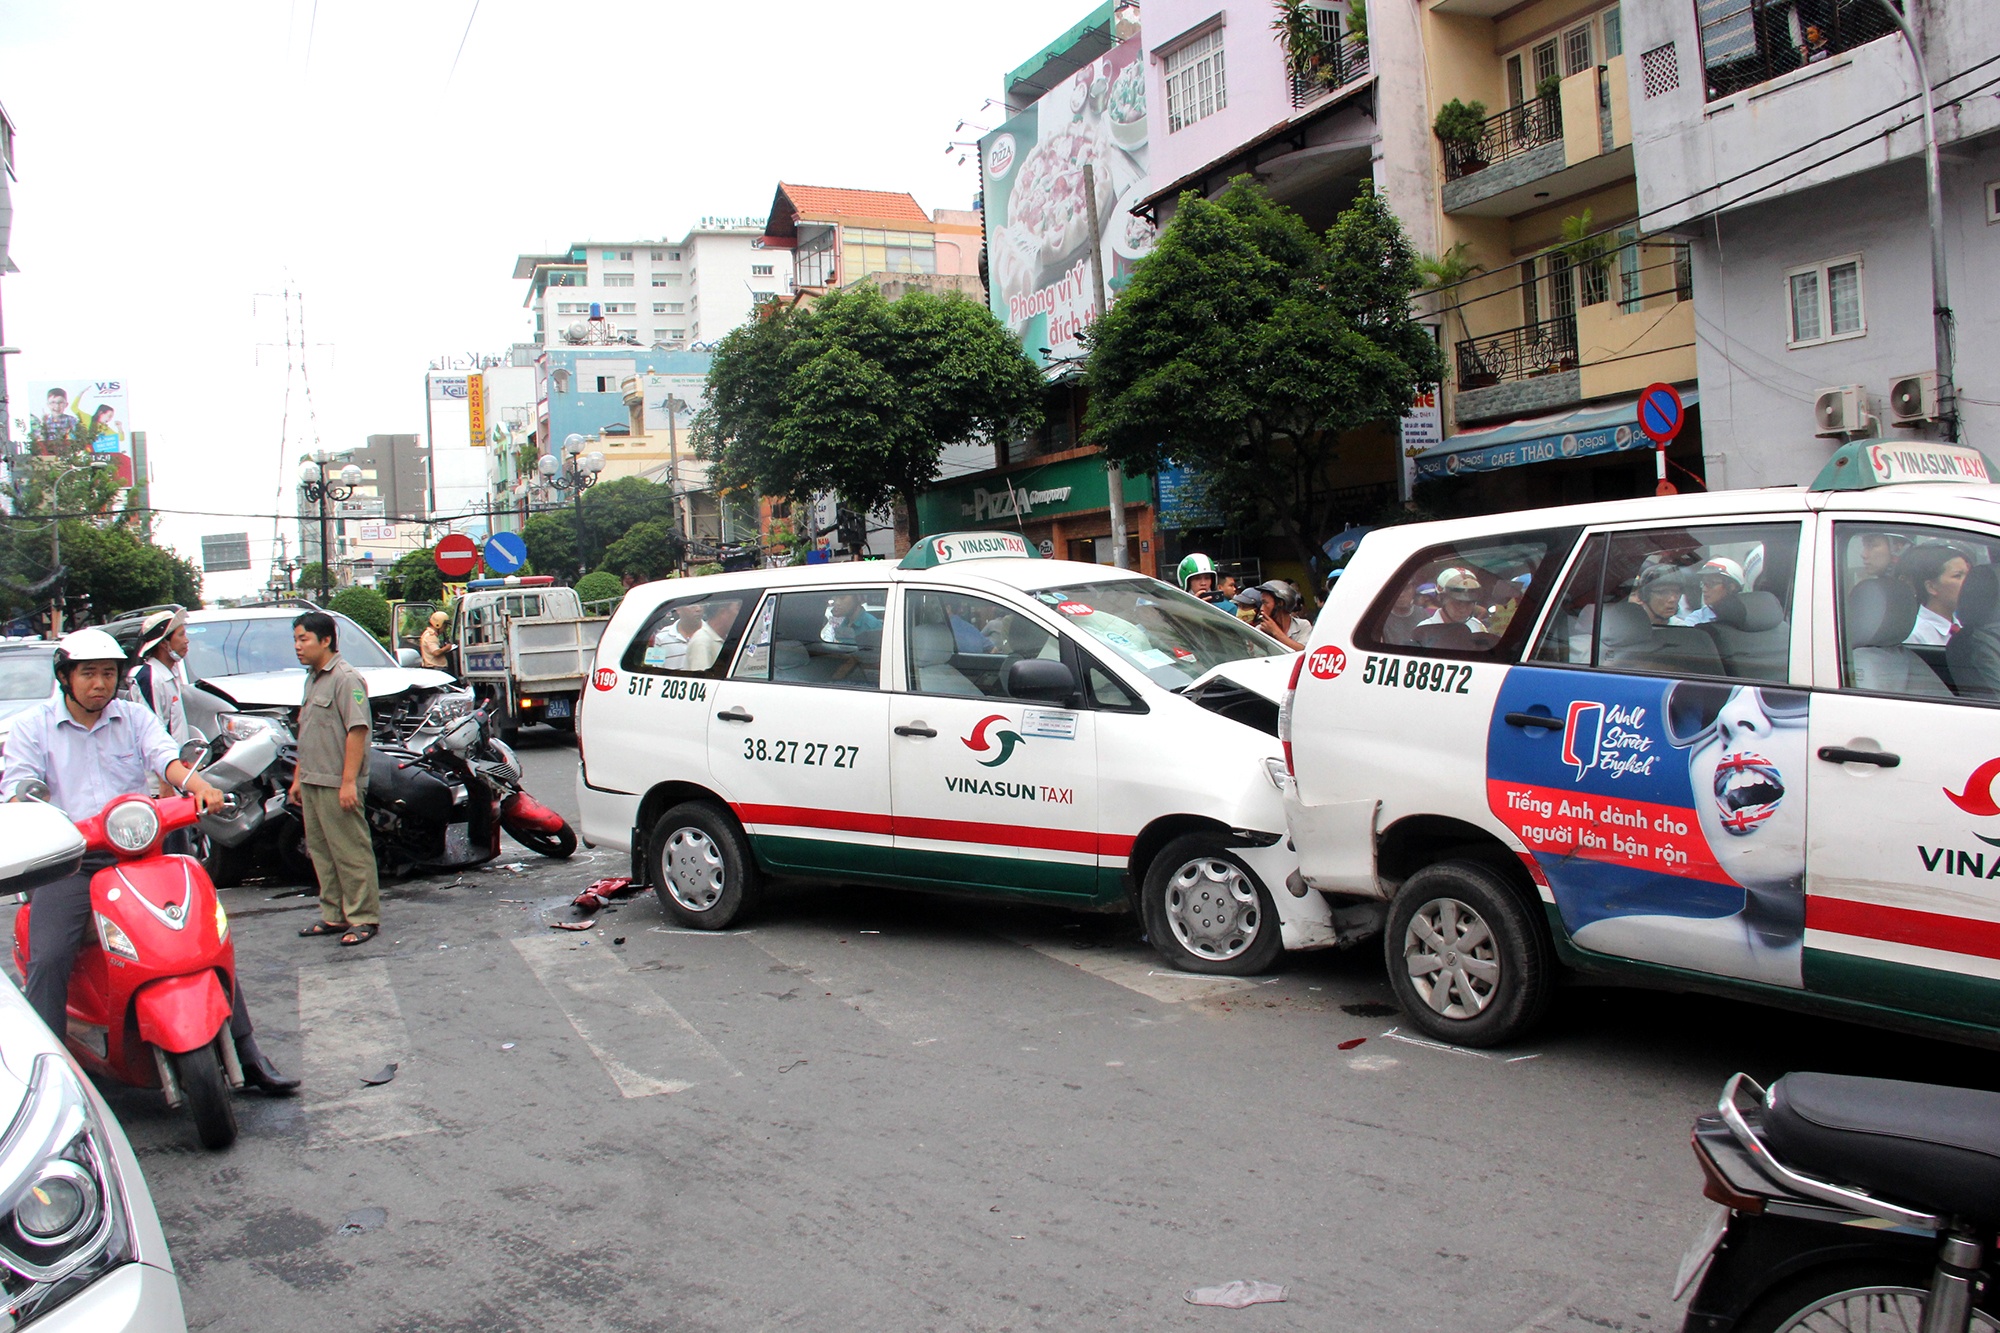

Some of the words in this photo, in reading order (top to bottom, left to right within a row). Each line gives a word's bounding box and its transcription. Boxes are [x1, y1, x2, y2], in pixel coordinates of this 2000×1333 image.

[1010, 286, 1055, 323] Phong
[1057, 272, 1072, 307] vị
[1073, 260, 1084, 296] Ý
[1049, 311, 1081, 346] đích
[1491, 450, 1515, 466] CAFÉ
[1521, 441, 1554, 461] THẢO
[1578, 433, 1606, 451] pepsi
[1893, 451, 1958, 475] VINASUN
[1954, 456, 1986, 478] TAXI
[974, 487, 1032, 521] PIZZA
[958, 538, 1007, 554] VINASUN
[1002, 537, 1025, 552] TAXI
[1311, 652, 1344, 675] 7542
[1363, 656, 1400, 687] 51A
[628, 676, 653, 696] 51F
[1605, 704, 1646, 729] Wall
[1602, 726, 1654, 752] Street
[744, 738, 799, 764] 38.27
[804, 742, 828, 766] 27
[834, 745, 859, 768] 27
[945, 776, 1035, 801] VINASUN
[1039, 786, 1073, 804] TAXI
[1507, 790, 1552, 818] Tiếng
[1558, 799, 1594, 821] Anh
[1600, 805, 1648, 829] dành
[1653, 814, 1688, 836] cho
[1522, 824, 1572, 844] người
[1578, 828, 1607, 849] lớn
[1613, 833, 1649, 859] bận
[1655, 843, 1688, 867] rộn
